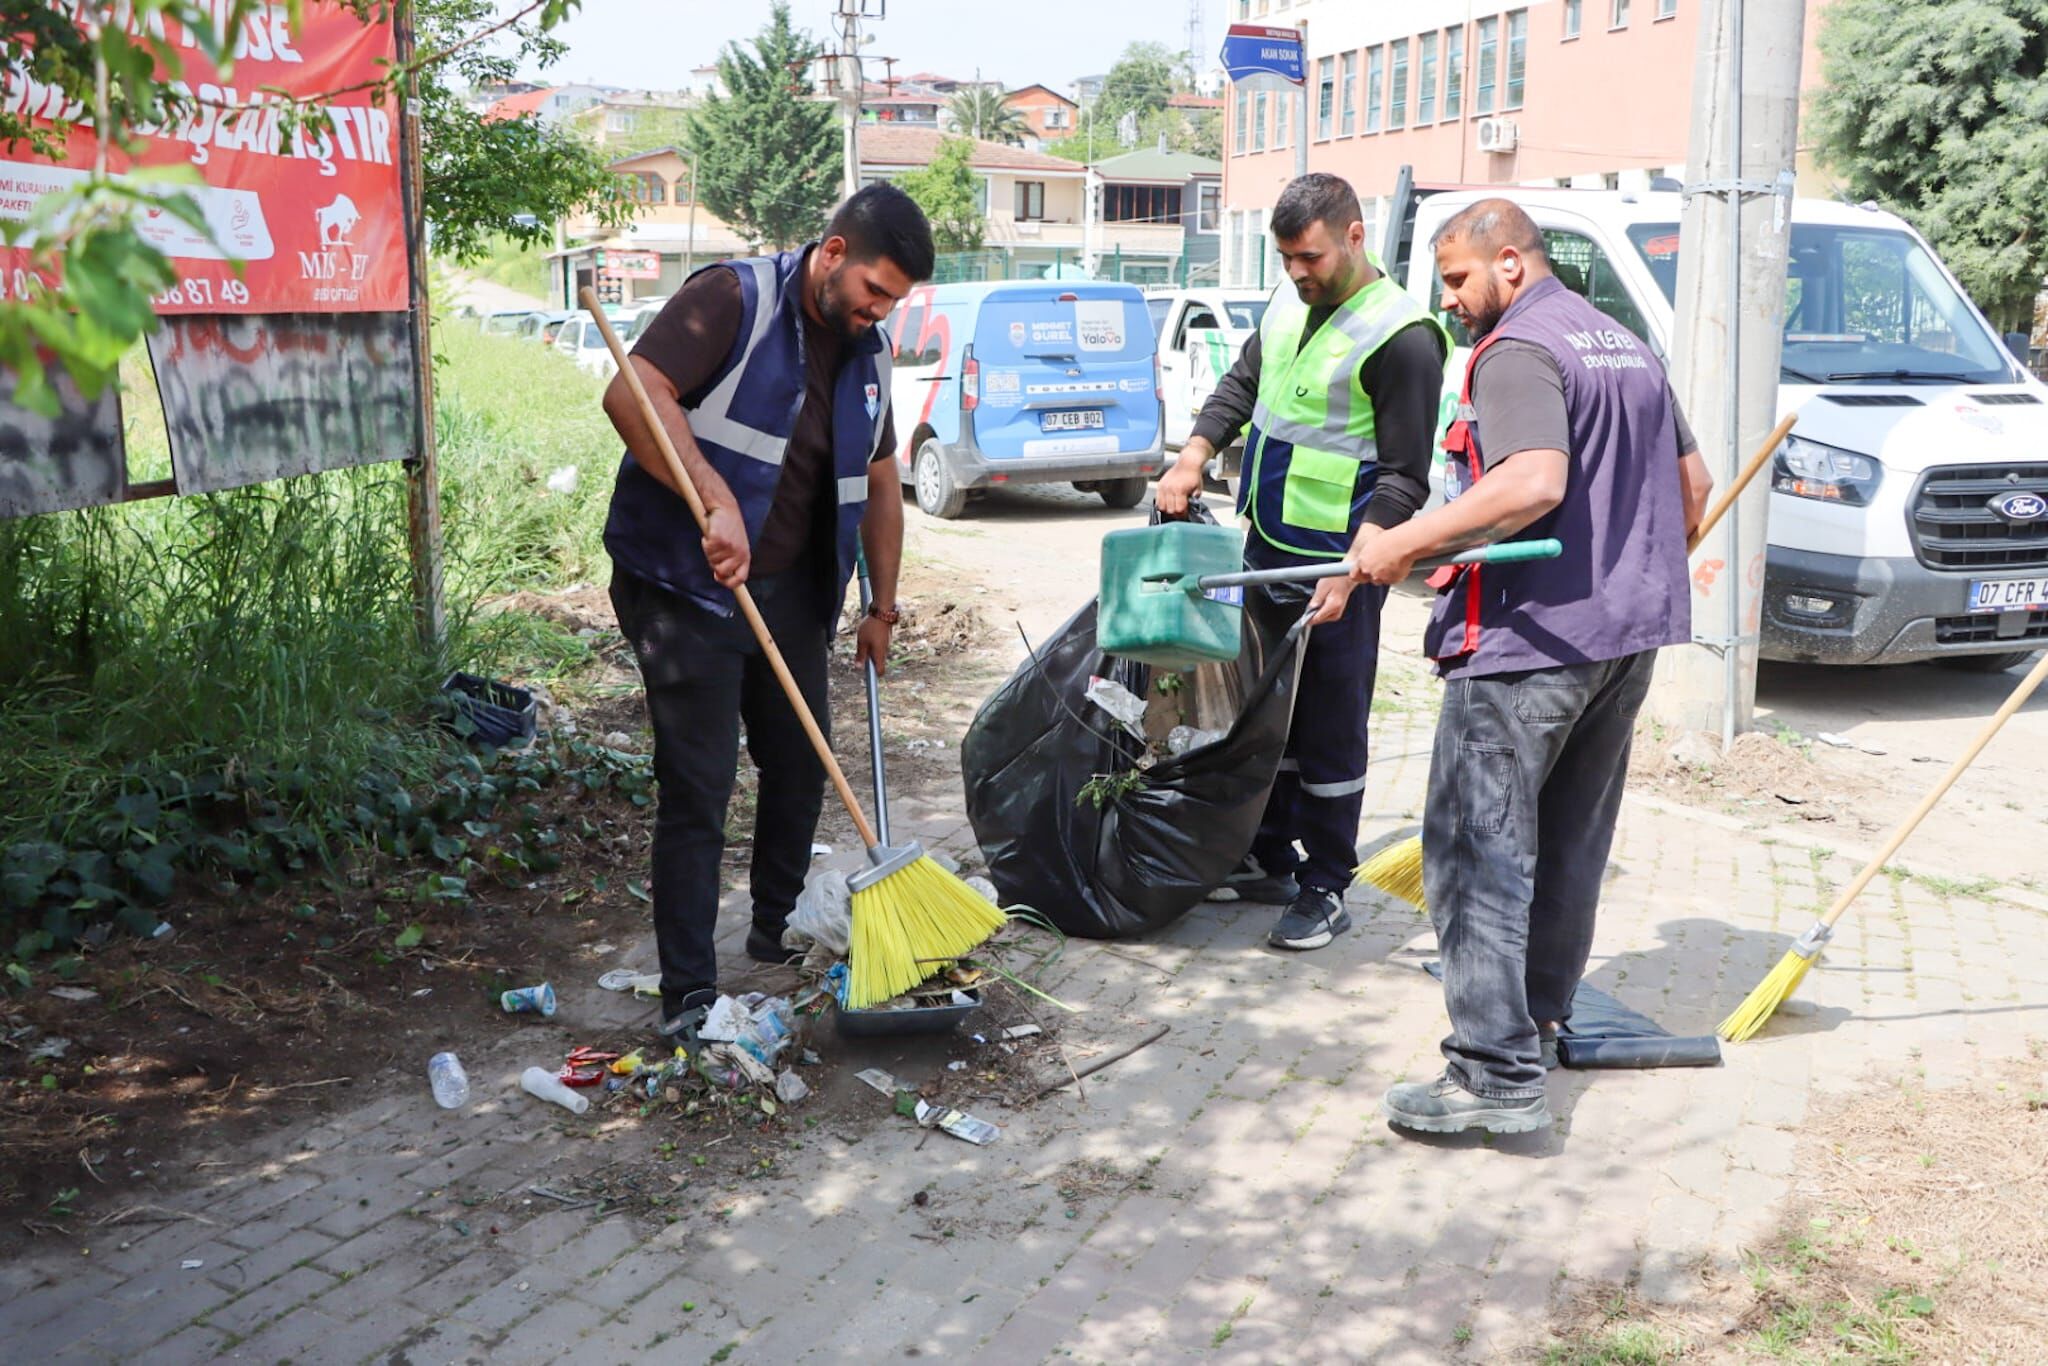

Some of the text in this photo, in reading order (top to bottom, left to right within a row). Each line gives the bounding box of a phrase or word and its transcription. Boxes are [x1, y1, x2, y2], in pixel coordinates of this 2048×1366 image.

[184, 278, 213, 305] 87
[220, 279, 249, 305] 49
[1046, 414, 1057, 426] 07
[1062, 413, 1080, 425] CEB
[2010, 499, 2039, 514] Ford
[1980, 583, 2000, 604] 07
[2005, 581, 2036, 603] CFR
